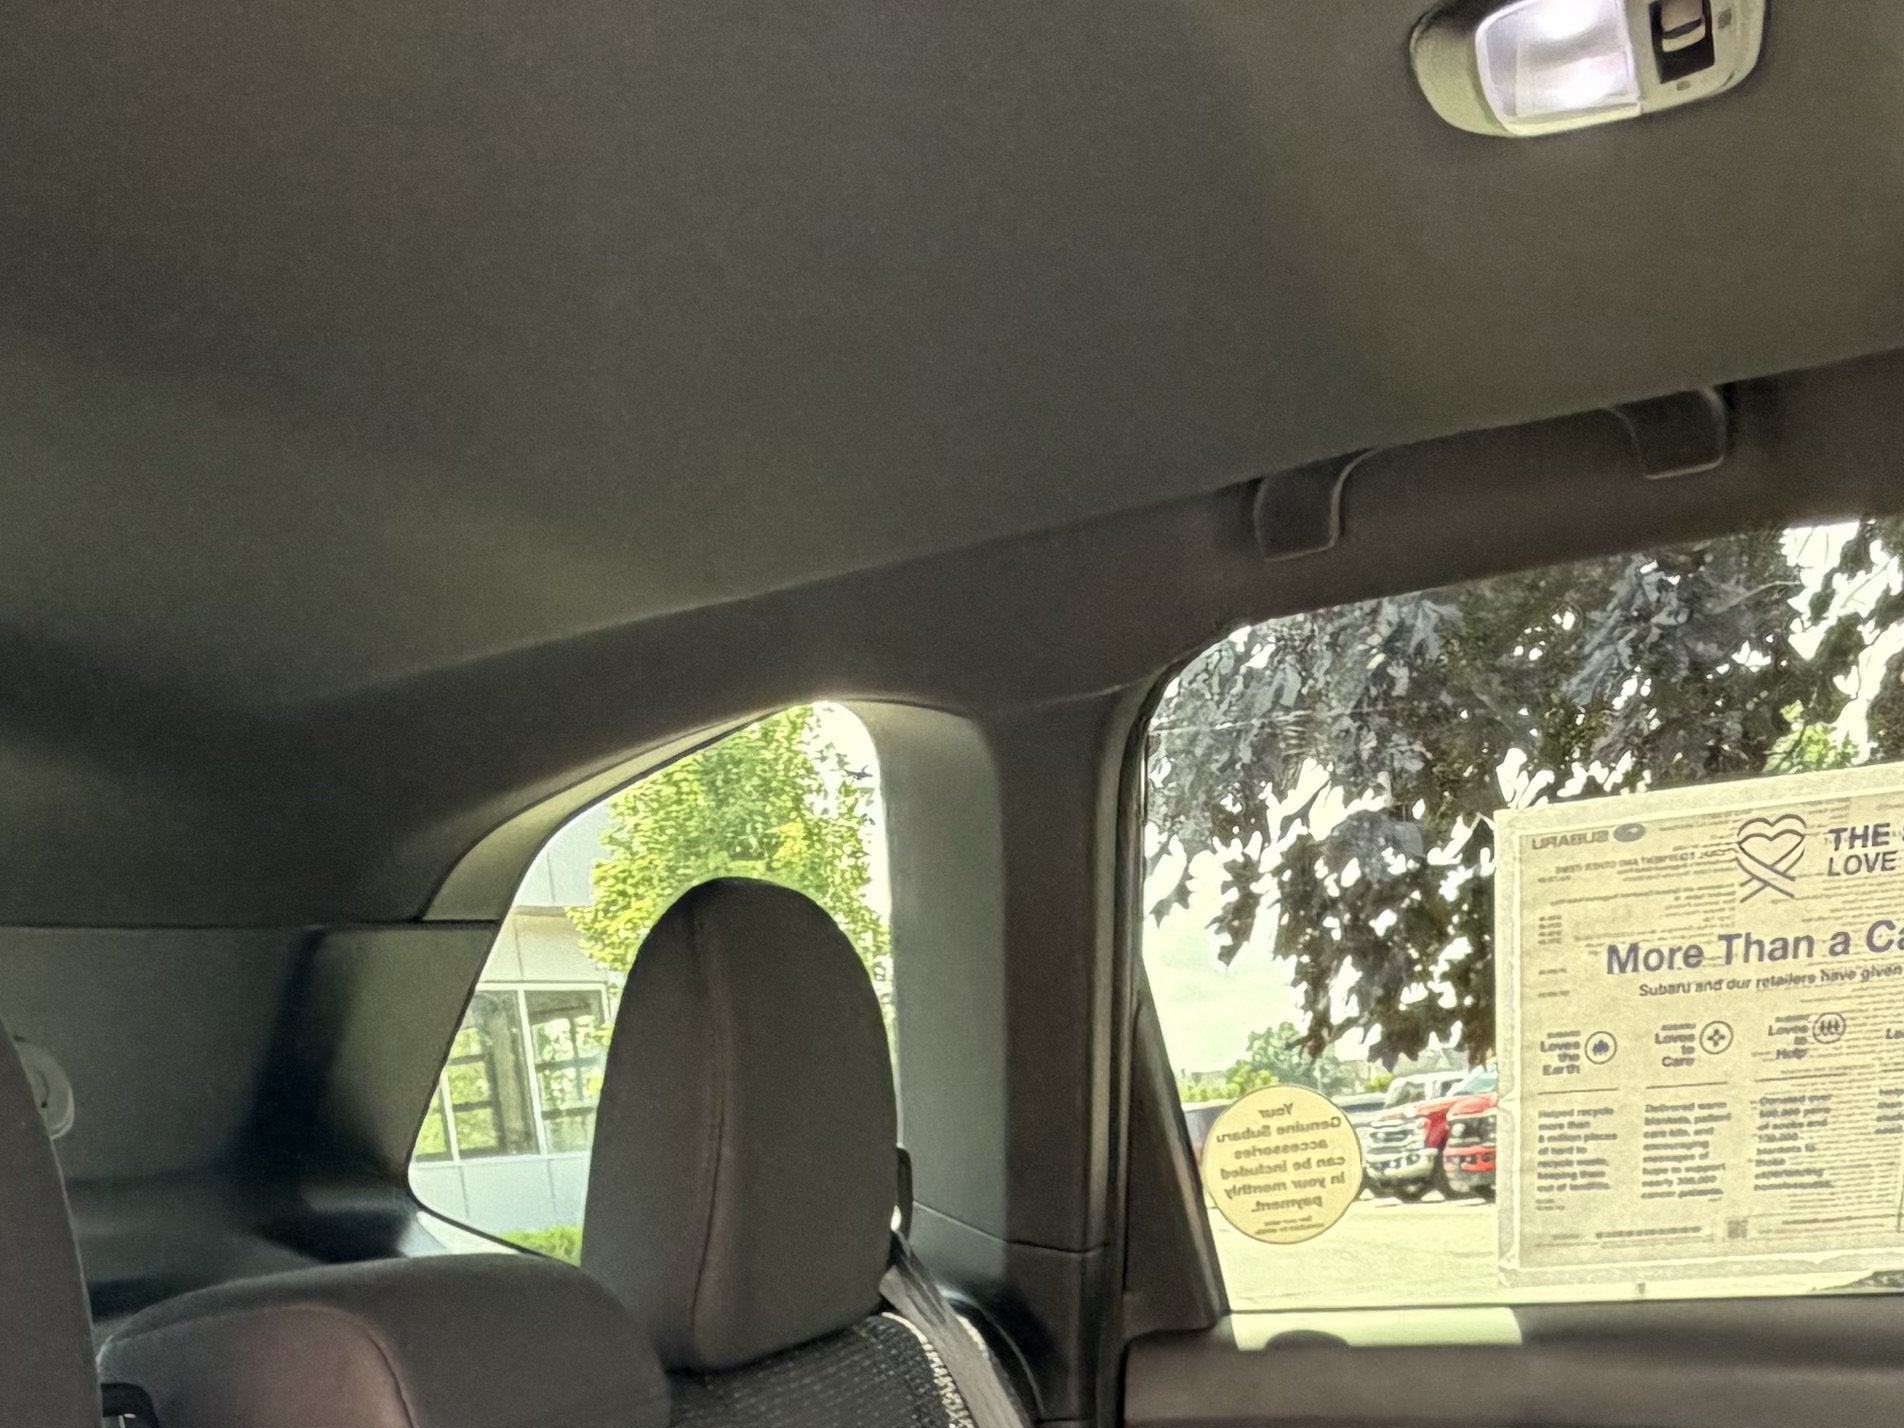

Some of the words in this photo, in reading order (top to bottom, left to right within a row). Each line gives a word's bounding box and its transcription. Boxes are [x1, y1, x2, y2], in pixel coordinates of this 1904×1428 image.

[1828, 822, 1891, 851] THE
[1827, 850, 1897, 877] LOVE
[1607, 942, 1704, 975] More
[1717, 931, 1815, 966] Than
[1828, 930, 1851, 957] a
[1639, 981, 1692, 997] Subaru
[1695, 977, 1723, 993] and
[1726, 977, 1752, 991] our
[1756, 972, 1815, 989] retailers
[1820, 967, 1857, 982] have
[1860, 963, 1903, 982] given
[1542, 1064, 1580, 1076] Earth
